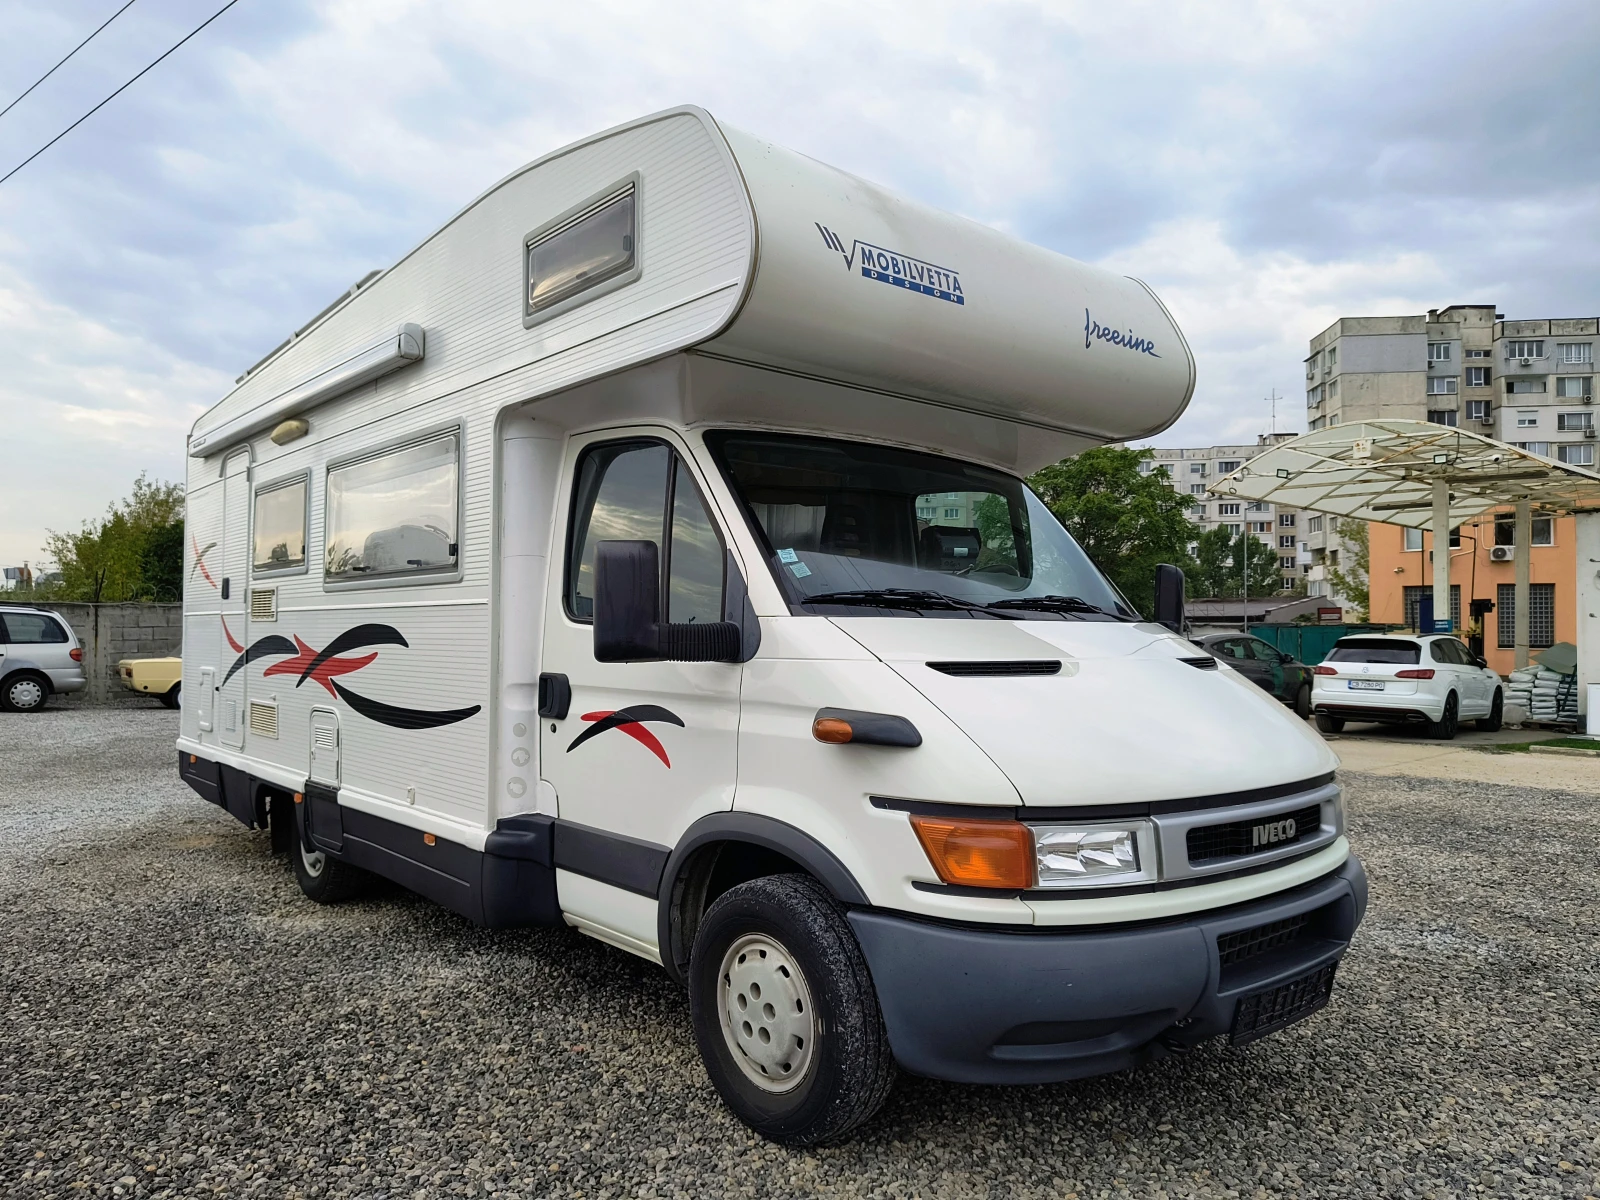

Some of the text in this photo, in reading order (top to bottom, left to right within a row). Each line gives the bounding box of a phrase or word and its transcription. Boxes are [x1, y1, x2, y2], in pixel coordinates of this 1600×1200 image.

[861, 246, 963, 294] MOBILVETTA
[871, 270, 957, 302] DESIGN
[1252, 818, 1296, 847] IVECO
